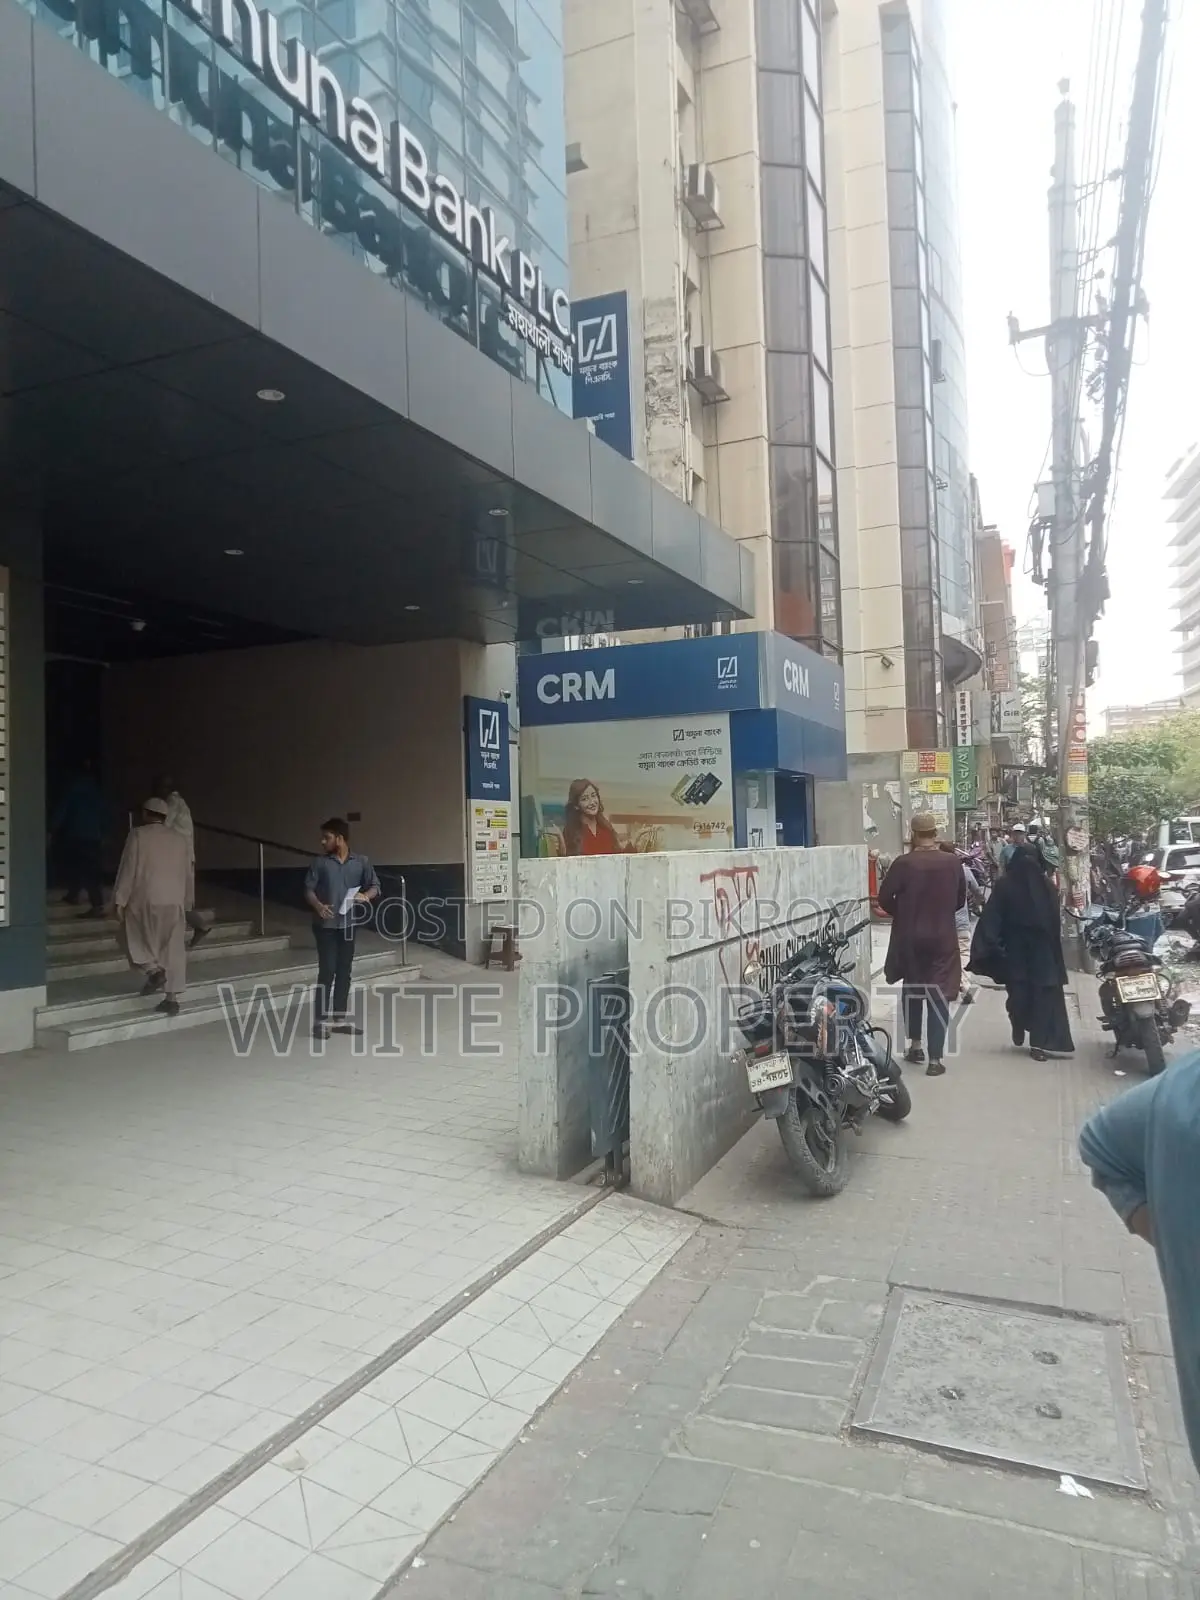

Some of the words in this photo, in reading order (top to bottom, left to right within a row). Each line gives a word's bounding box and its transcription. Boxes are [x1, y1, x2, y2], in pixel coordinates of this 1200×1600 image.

[398, 120, 512, 287] Bank
[518, 250, 577, 345] PLC.
[536, 668, 616, 704] CRM
[783, 658, 809, 698] CRM
[702, 822, 726, 830] 16742
